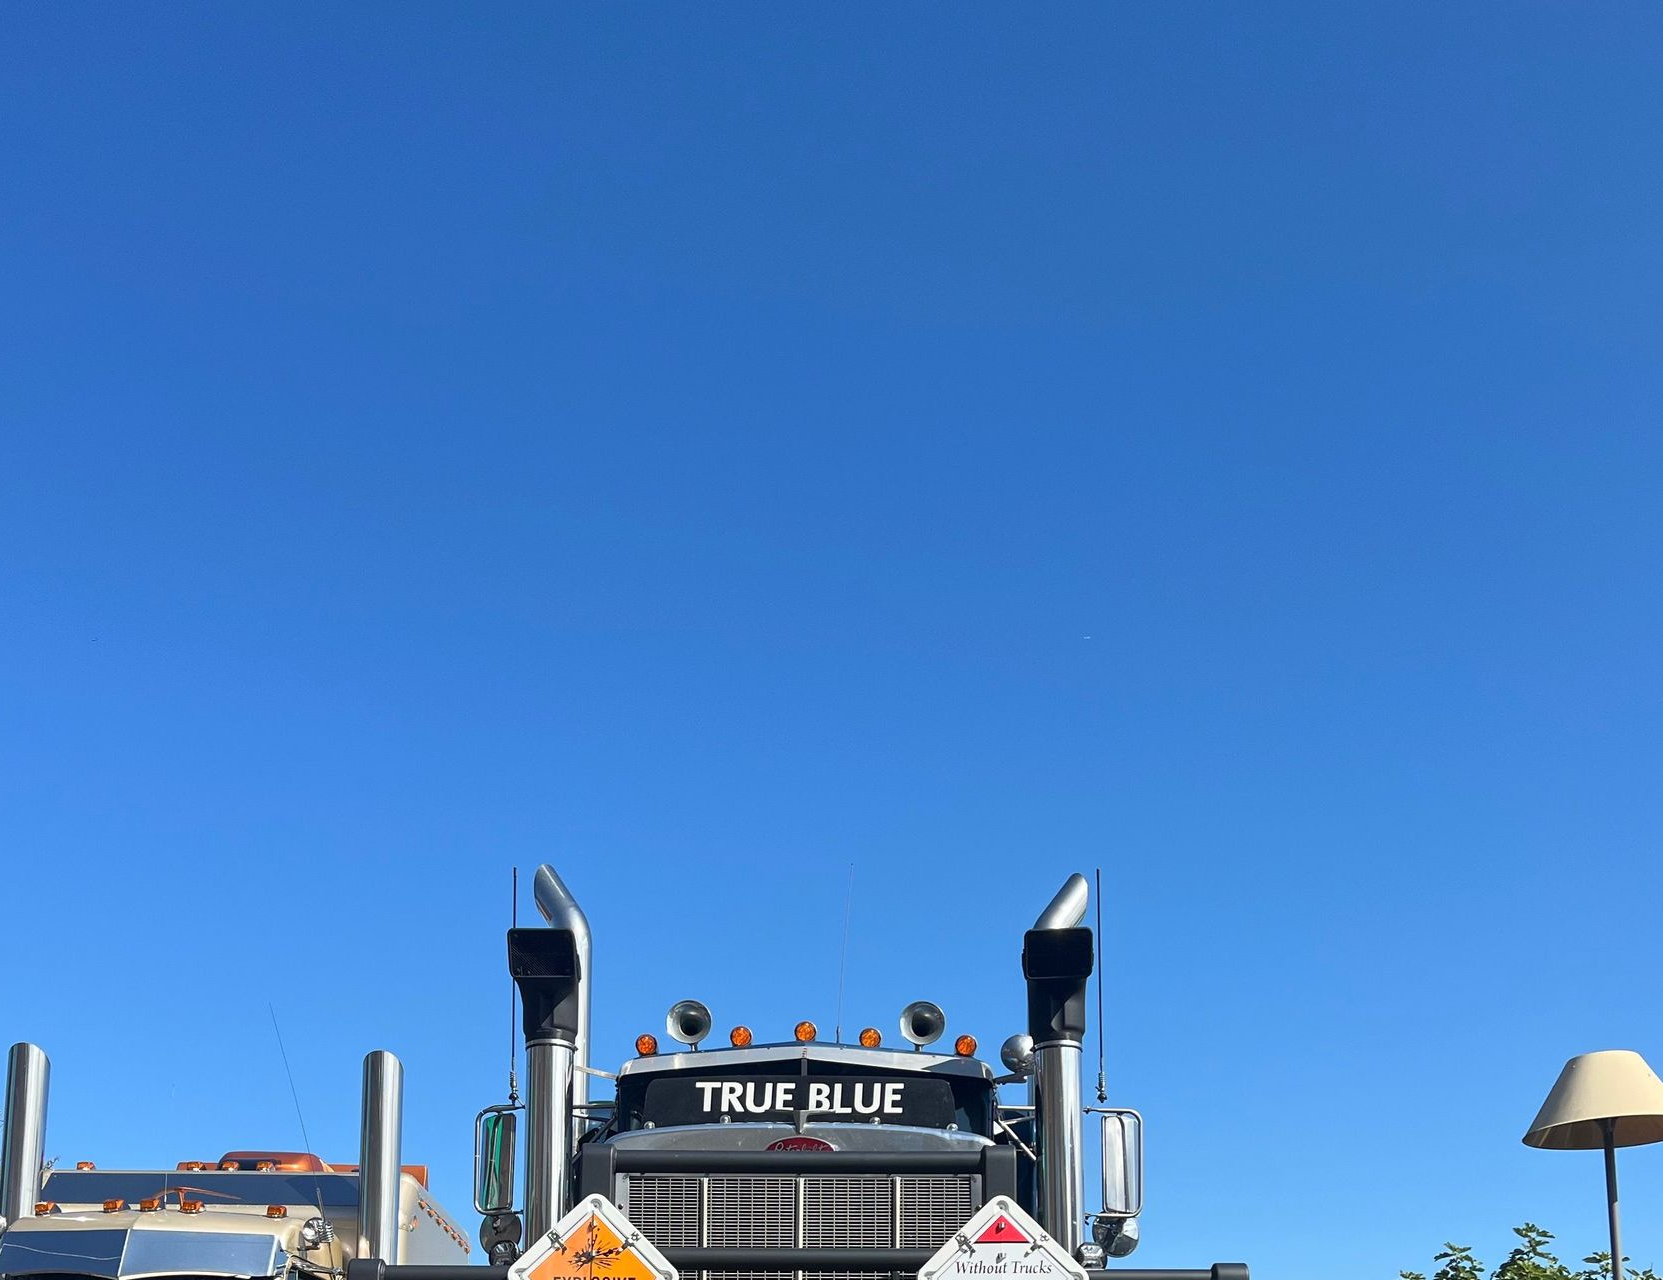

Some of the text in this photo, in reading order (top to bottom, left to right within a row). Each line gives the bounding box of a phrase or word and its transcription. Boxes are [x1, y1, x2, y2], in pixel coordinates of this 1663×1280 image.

[695, 1081, 905, 1114] TRUE BLUE
[955, 1260, 1052, 1275] Without Trucks
